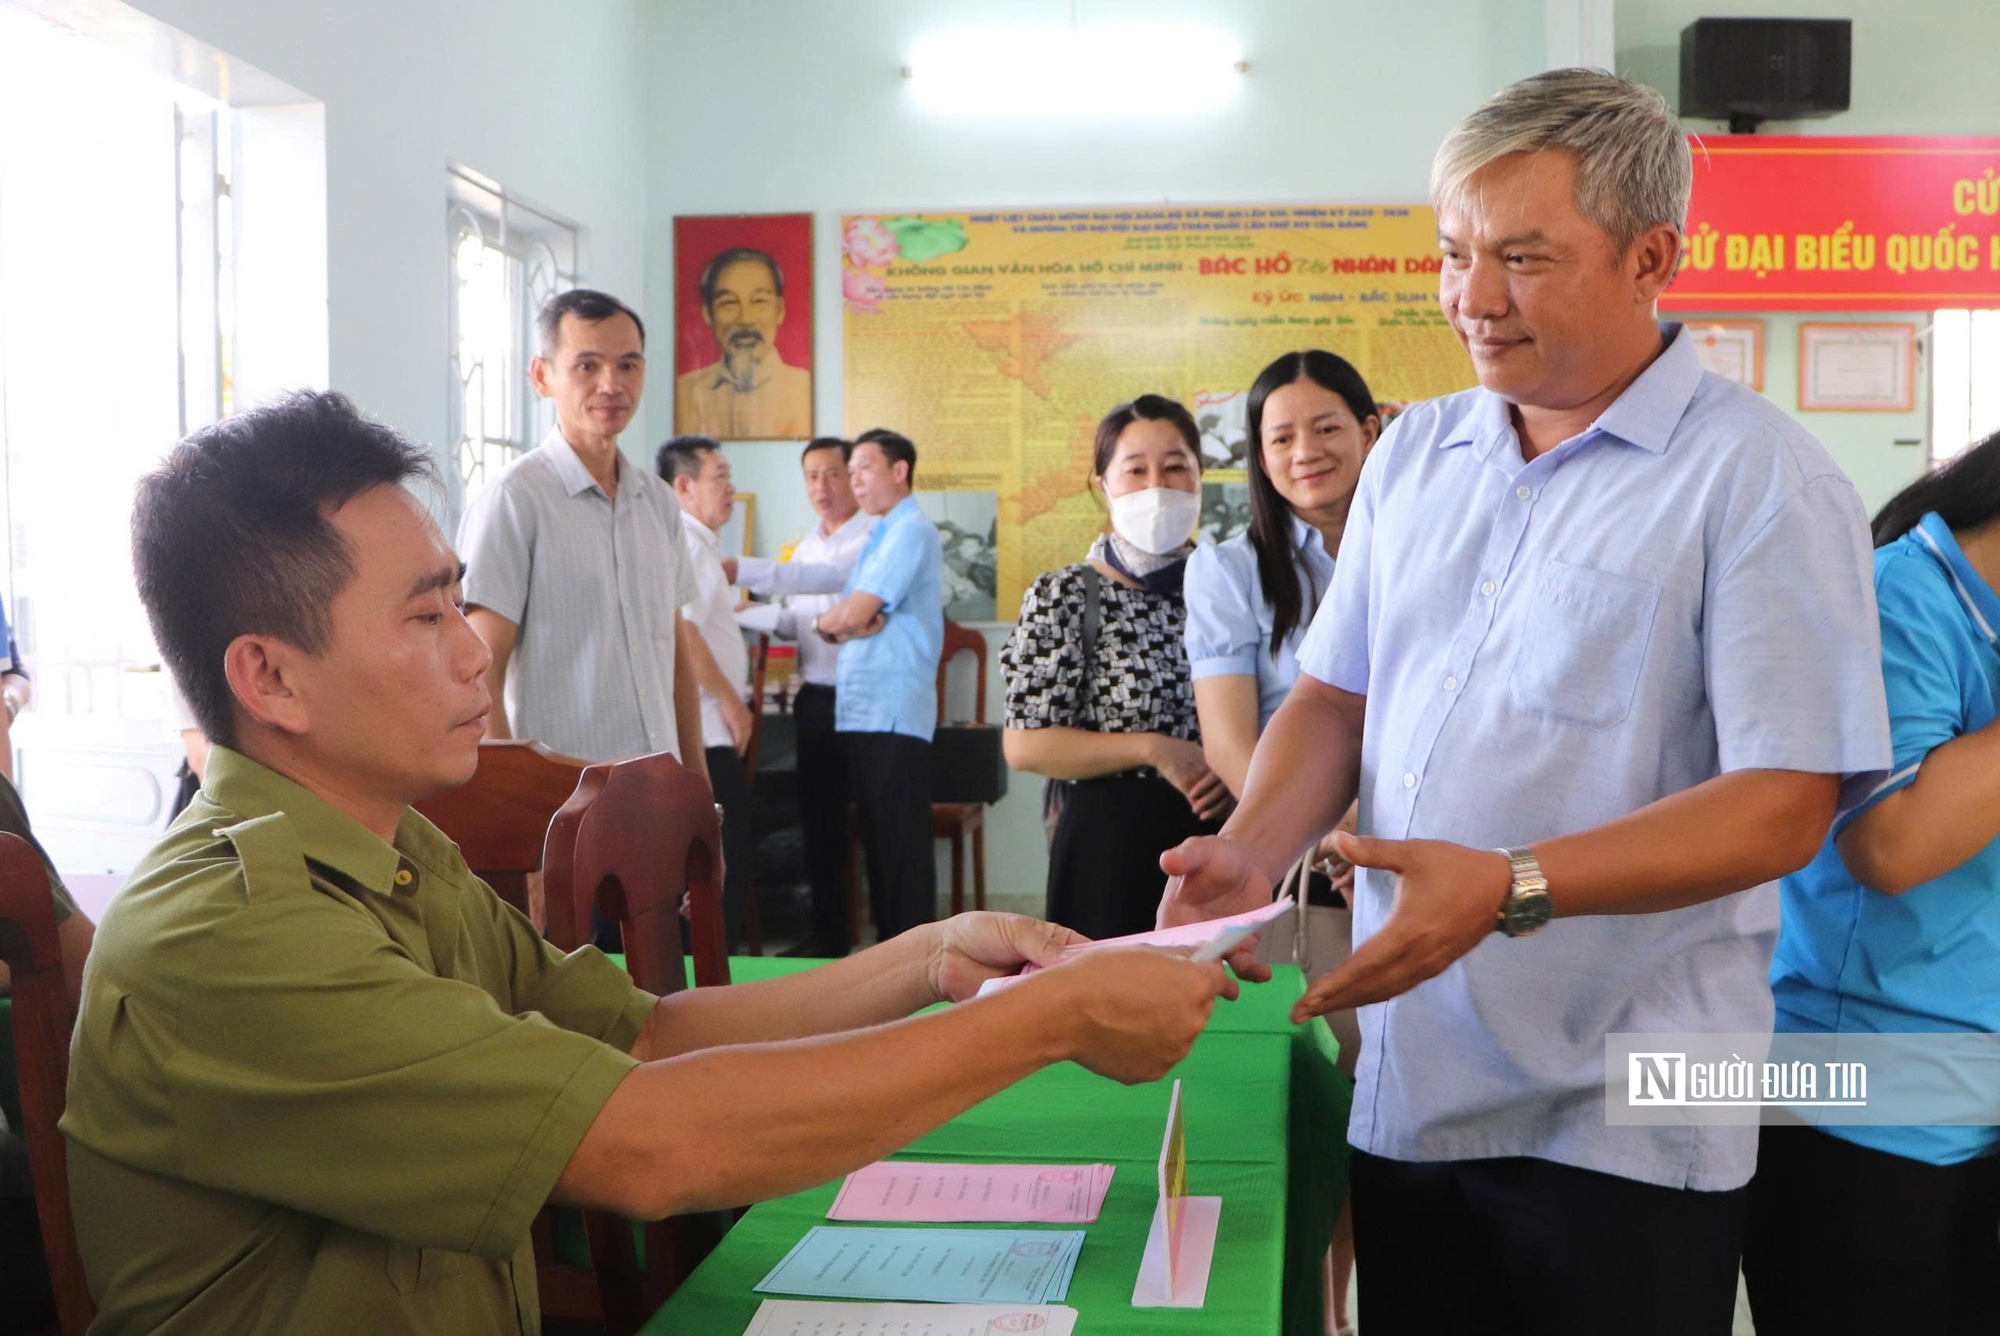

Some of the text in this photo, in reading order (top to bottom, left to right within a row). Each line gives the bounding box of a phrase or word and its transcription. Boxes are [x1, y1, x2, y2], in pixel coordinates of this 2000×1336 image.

[886, 263, 947, 276] KHÔNG
[952, 265, 993, 275] GIAN
[999, 260, 1035, 274] VĂN
[1080, 258, 1103, 272] HỒ
[1108, 260, 1134, 272] CHÍ
[1140, 261, 1183, 272] MINH
[1199, 252, 1247, 275] BÁC
[1254, 249, 1291, 275] HỒ
[1332, 254, 1396, 274] NHÂN
[1725, 234, 1784, 279] ĐẠI
[1796, 220, 1875, 271] BIỂU
[1886, 222, 1978, 275] QUỐC
